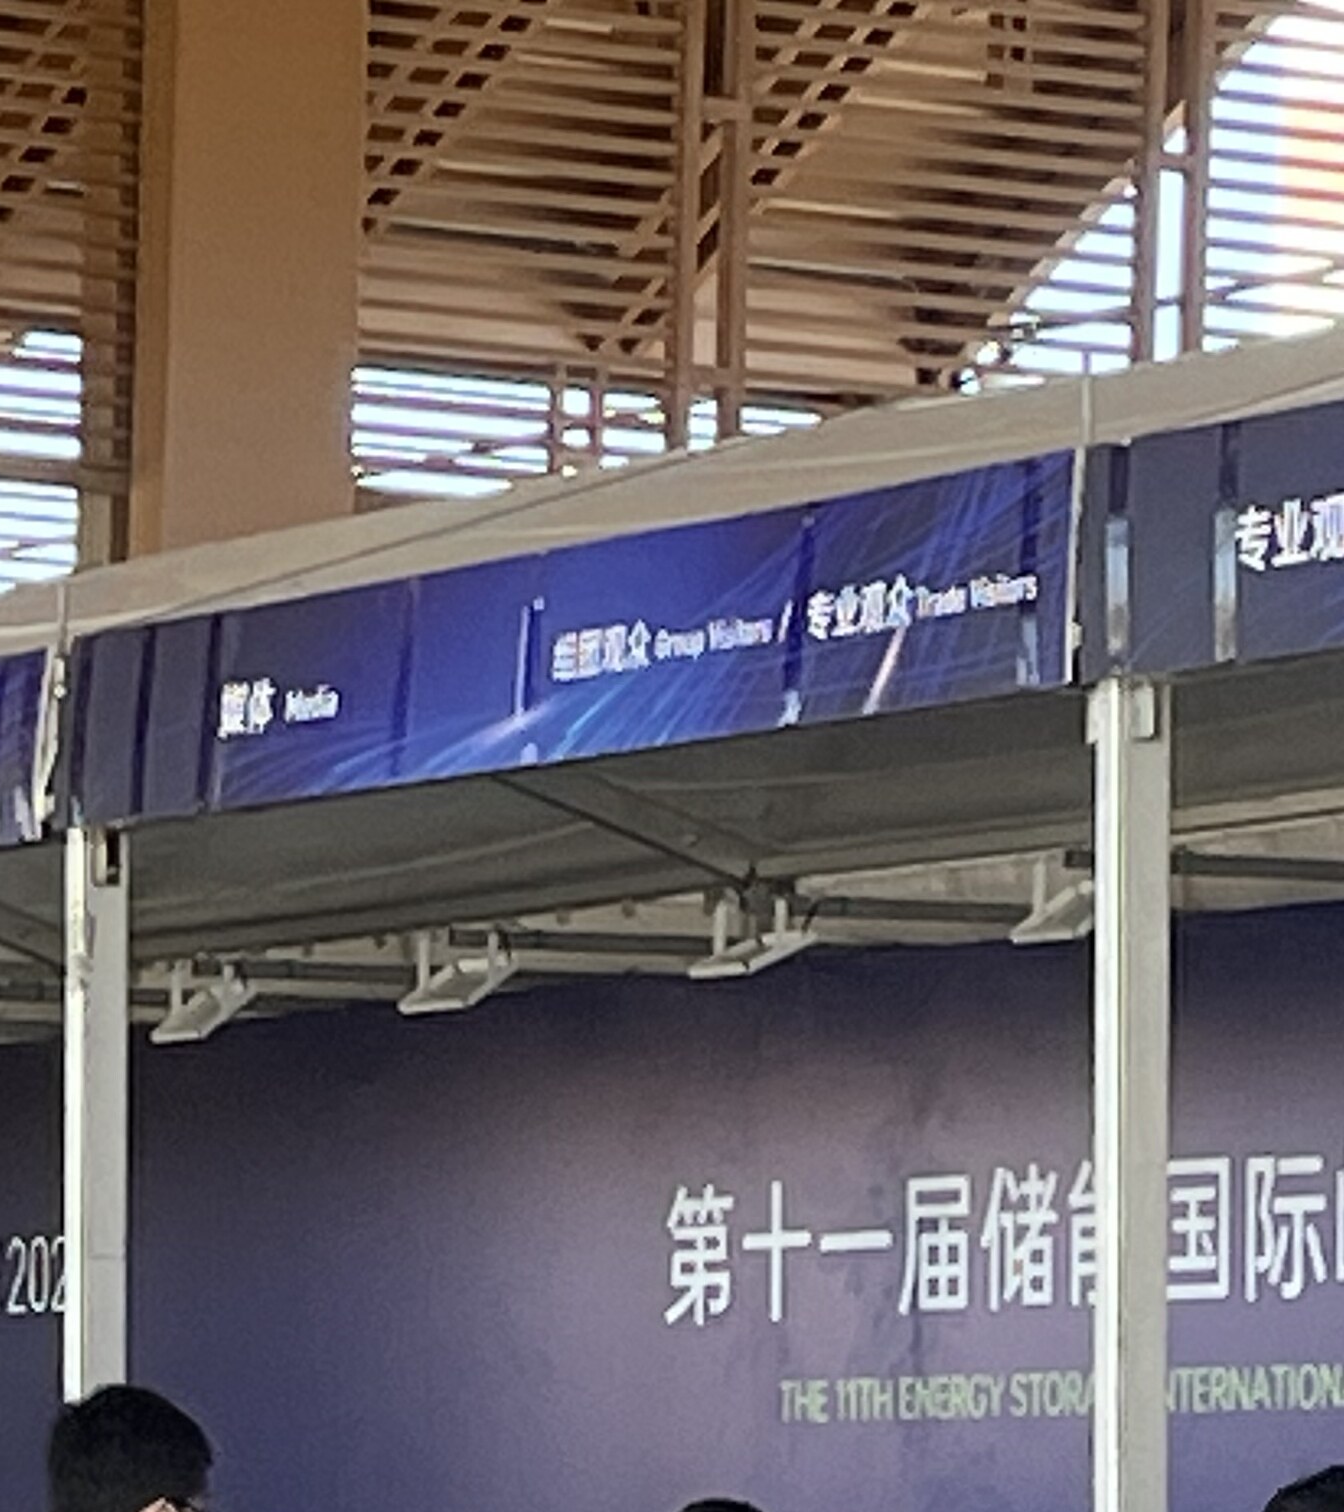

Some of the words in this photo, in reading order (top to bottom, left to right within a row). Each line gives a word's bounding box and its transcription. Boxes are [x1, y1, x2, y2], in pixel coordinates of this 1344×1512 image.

[807, 574, 914, 640] 专业观众
[5, 1235, 66, 1315] 202
[779, 1379, 829, 1424] THE
[897, 1374, 1003, 1421] ENERGY
